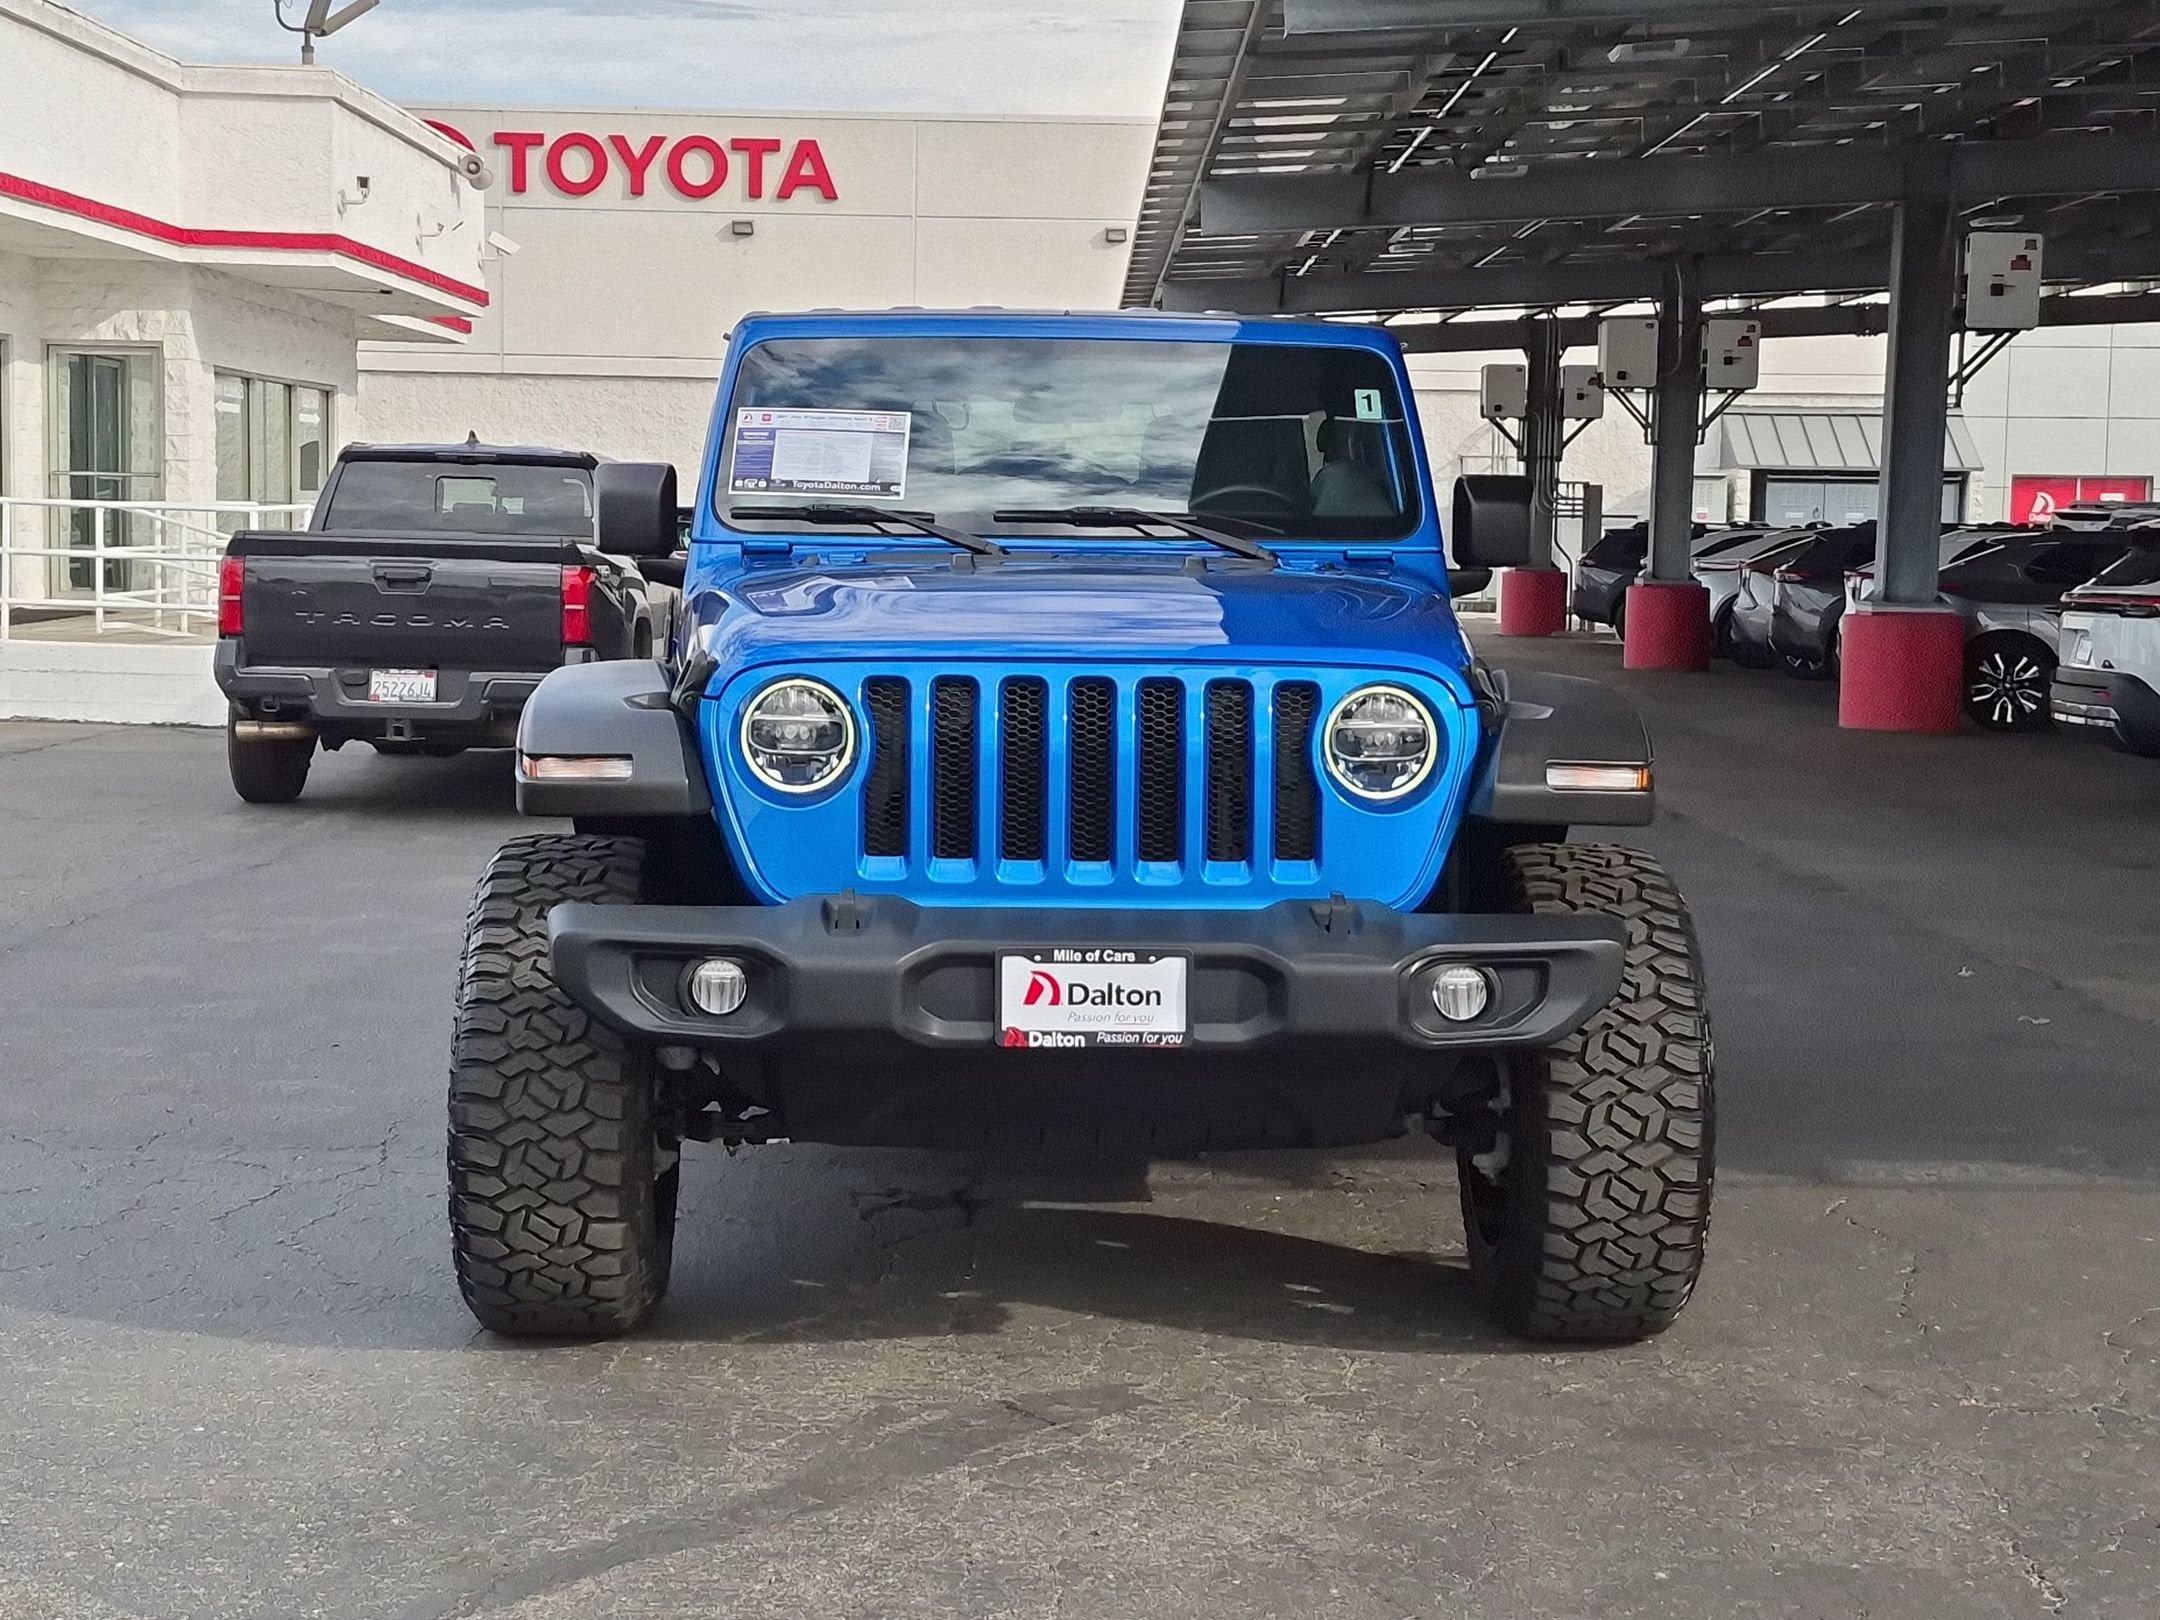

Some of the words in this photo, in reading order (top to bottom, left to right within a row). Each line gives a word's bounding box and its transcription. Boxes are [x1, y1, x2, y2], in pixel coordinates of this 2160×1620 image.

[493, 132, 839, 199] TOYOTA
[1361, 394, 1373, 412] 1
[791, 480, 881, 492] ToyotaDalton.com
[295, 612, 510, 629] TACOMA
[1053, 949, 1084, 962] Mile
[1087, 949, 1101, 962] of
[1103, 949, 1136, 962] Cars
[1067, 982, 1161, 1007] Dalton
[1067, 1011, 1111, 1022] Passion
[1114, 1011, 1131, 1022] for
[1132, 1014, 1155, 1024] you
[1028, 1031, 1086, 1047] Dalton
[1096, 1032, 1140, 1043] Passion
[1142, 1032, 1159, 1043] for
[1160, 1034, 1183, 1046] you
